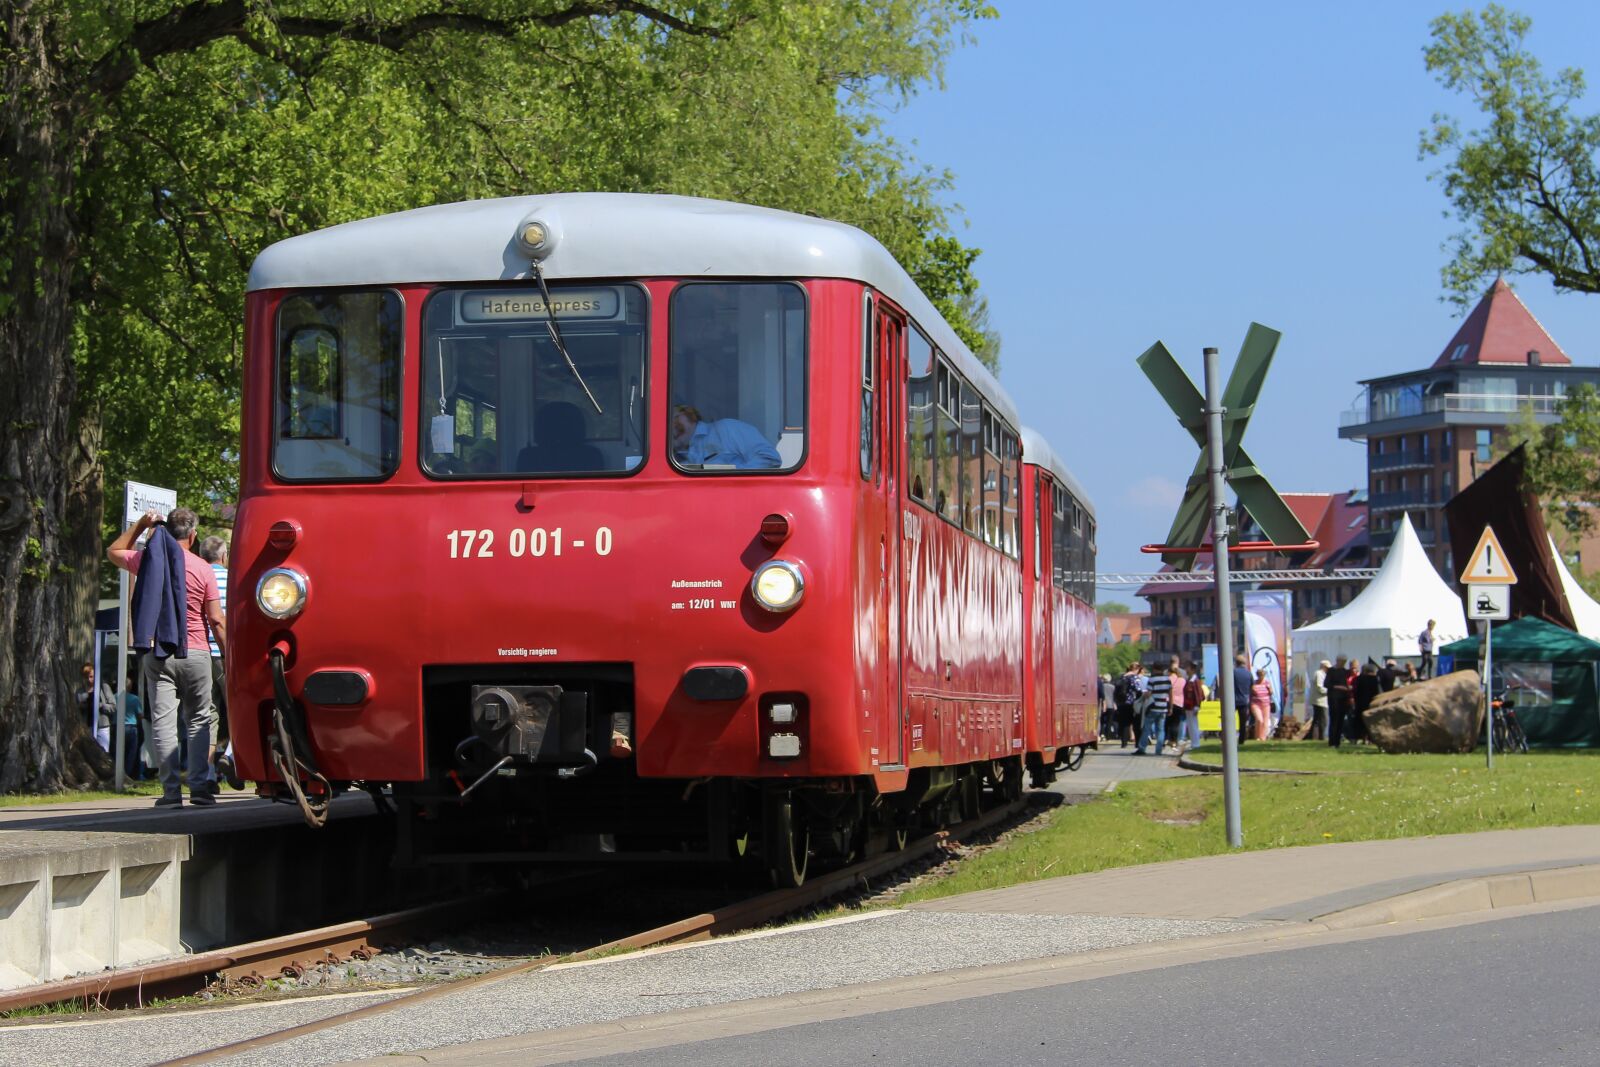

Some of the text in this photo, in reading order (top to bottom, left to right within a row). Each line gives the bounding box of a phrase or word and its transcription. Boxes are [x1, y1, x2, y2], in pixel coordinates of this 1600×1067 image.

[480, 299, 601, 315] Hafenexpress
[447, 529, 494, 559] 172
[509, 527, 562, 557] 001
[671, 579, 723, 588] Außenanstrich
[671, 599, 737, 610] am: 12/01 WNT
[497, 647, 557, 657] Vorsichtig rangieren
